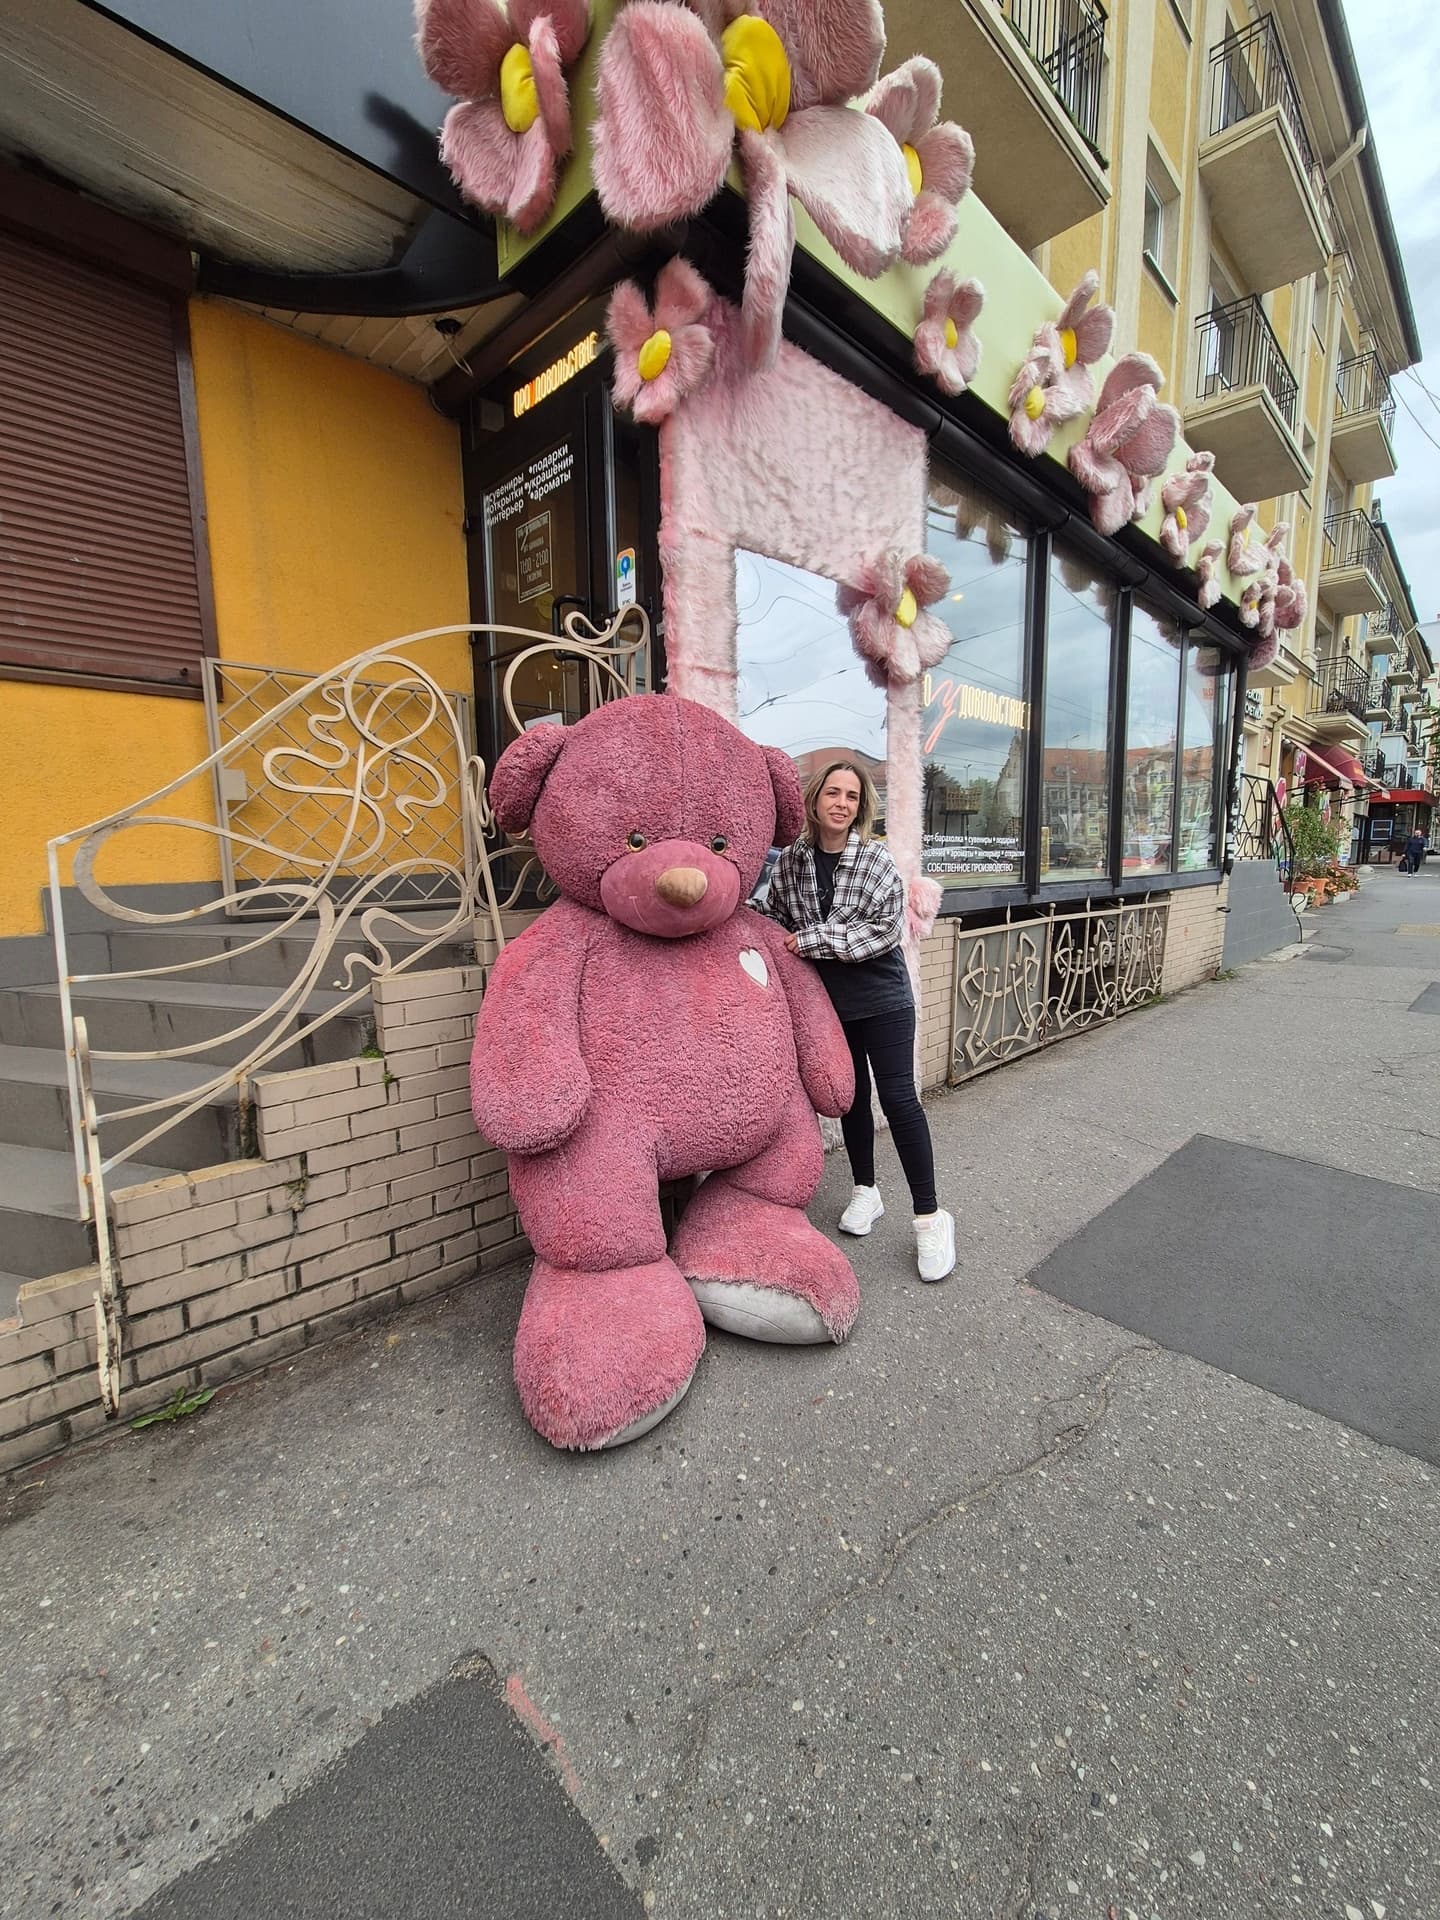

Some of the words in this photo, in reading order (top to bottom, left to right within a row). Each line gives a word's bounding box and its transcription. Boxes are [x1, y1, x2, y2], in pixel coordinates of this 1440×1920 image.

[489, 472, 524, 504] сувениры
[532, 443, 568, 474] подарки
[489, 486, 524, 514] открытки
[527, 454, 574, 494] украшения
[489, 499, 524, 526] интерьер
[534, 470, 571, 502] ароматы
[927, 862, 970, 873] СОБСТВЕННОЕ
[971, 863, 1014, 874] ПРОИЗВОДСТВО
